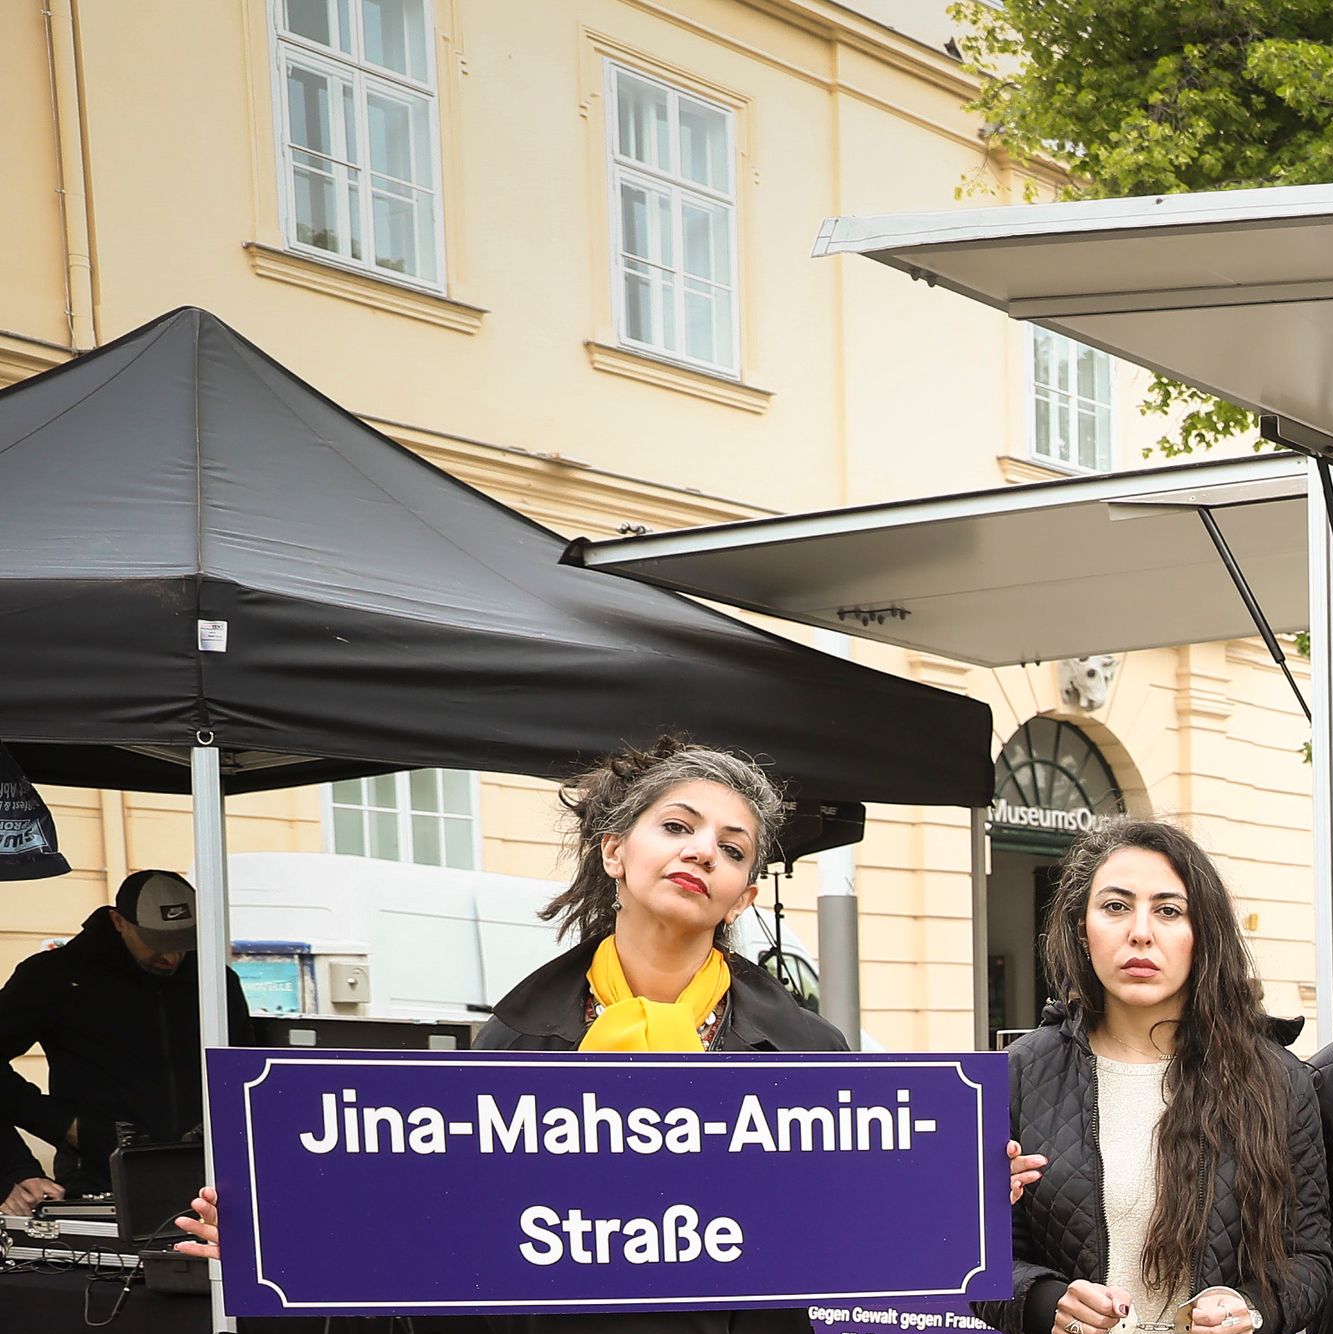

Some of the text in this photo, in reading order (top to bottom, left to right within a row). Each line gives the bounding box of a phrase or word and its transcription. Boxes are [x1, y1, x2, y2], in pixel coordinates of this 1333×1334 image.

[299, 1088, 937, 1155] Jina-Mahsa-Amini-
[519, 1204, 743, 1266] Straße
[808, 1305, 850, 1325] Gegen
[852, 1306, 899, 1325] Gewalt
[900, 1311, 943, 1331] gegen
